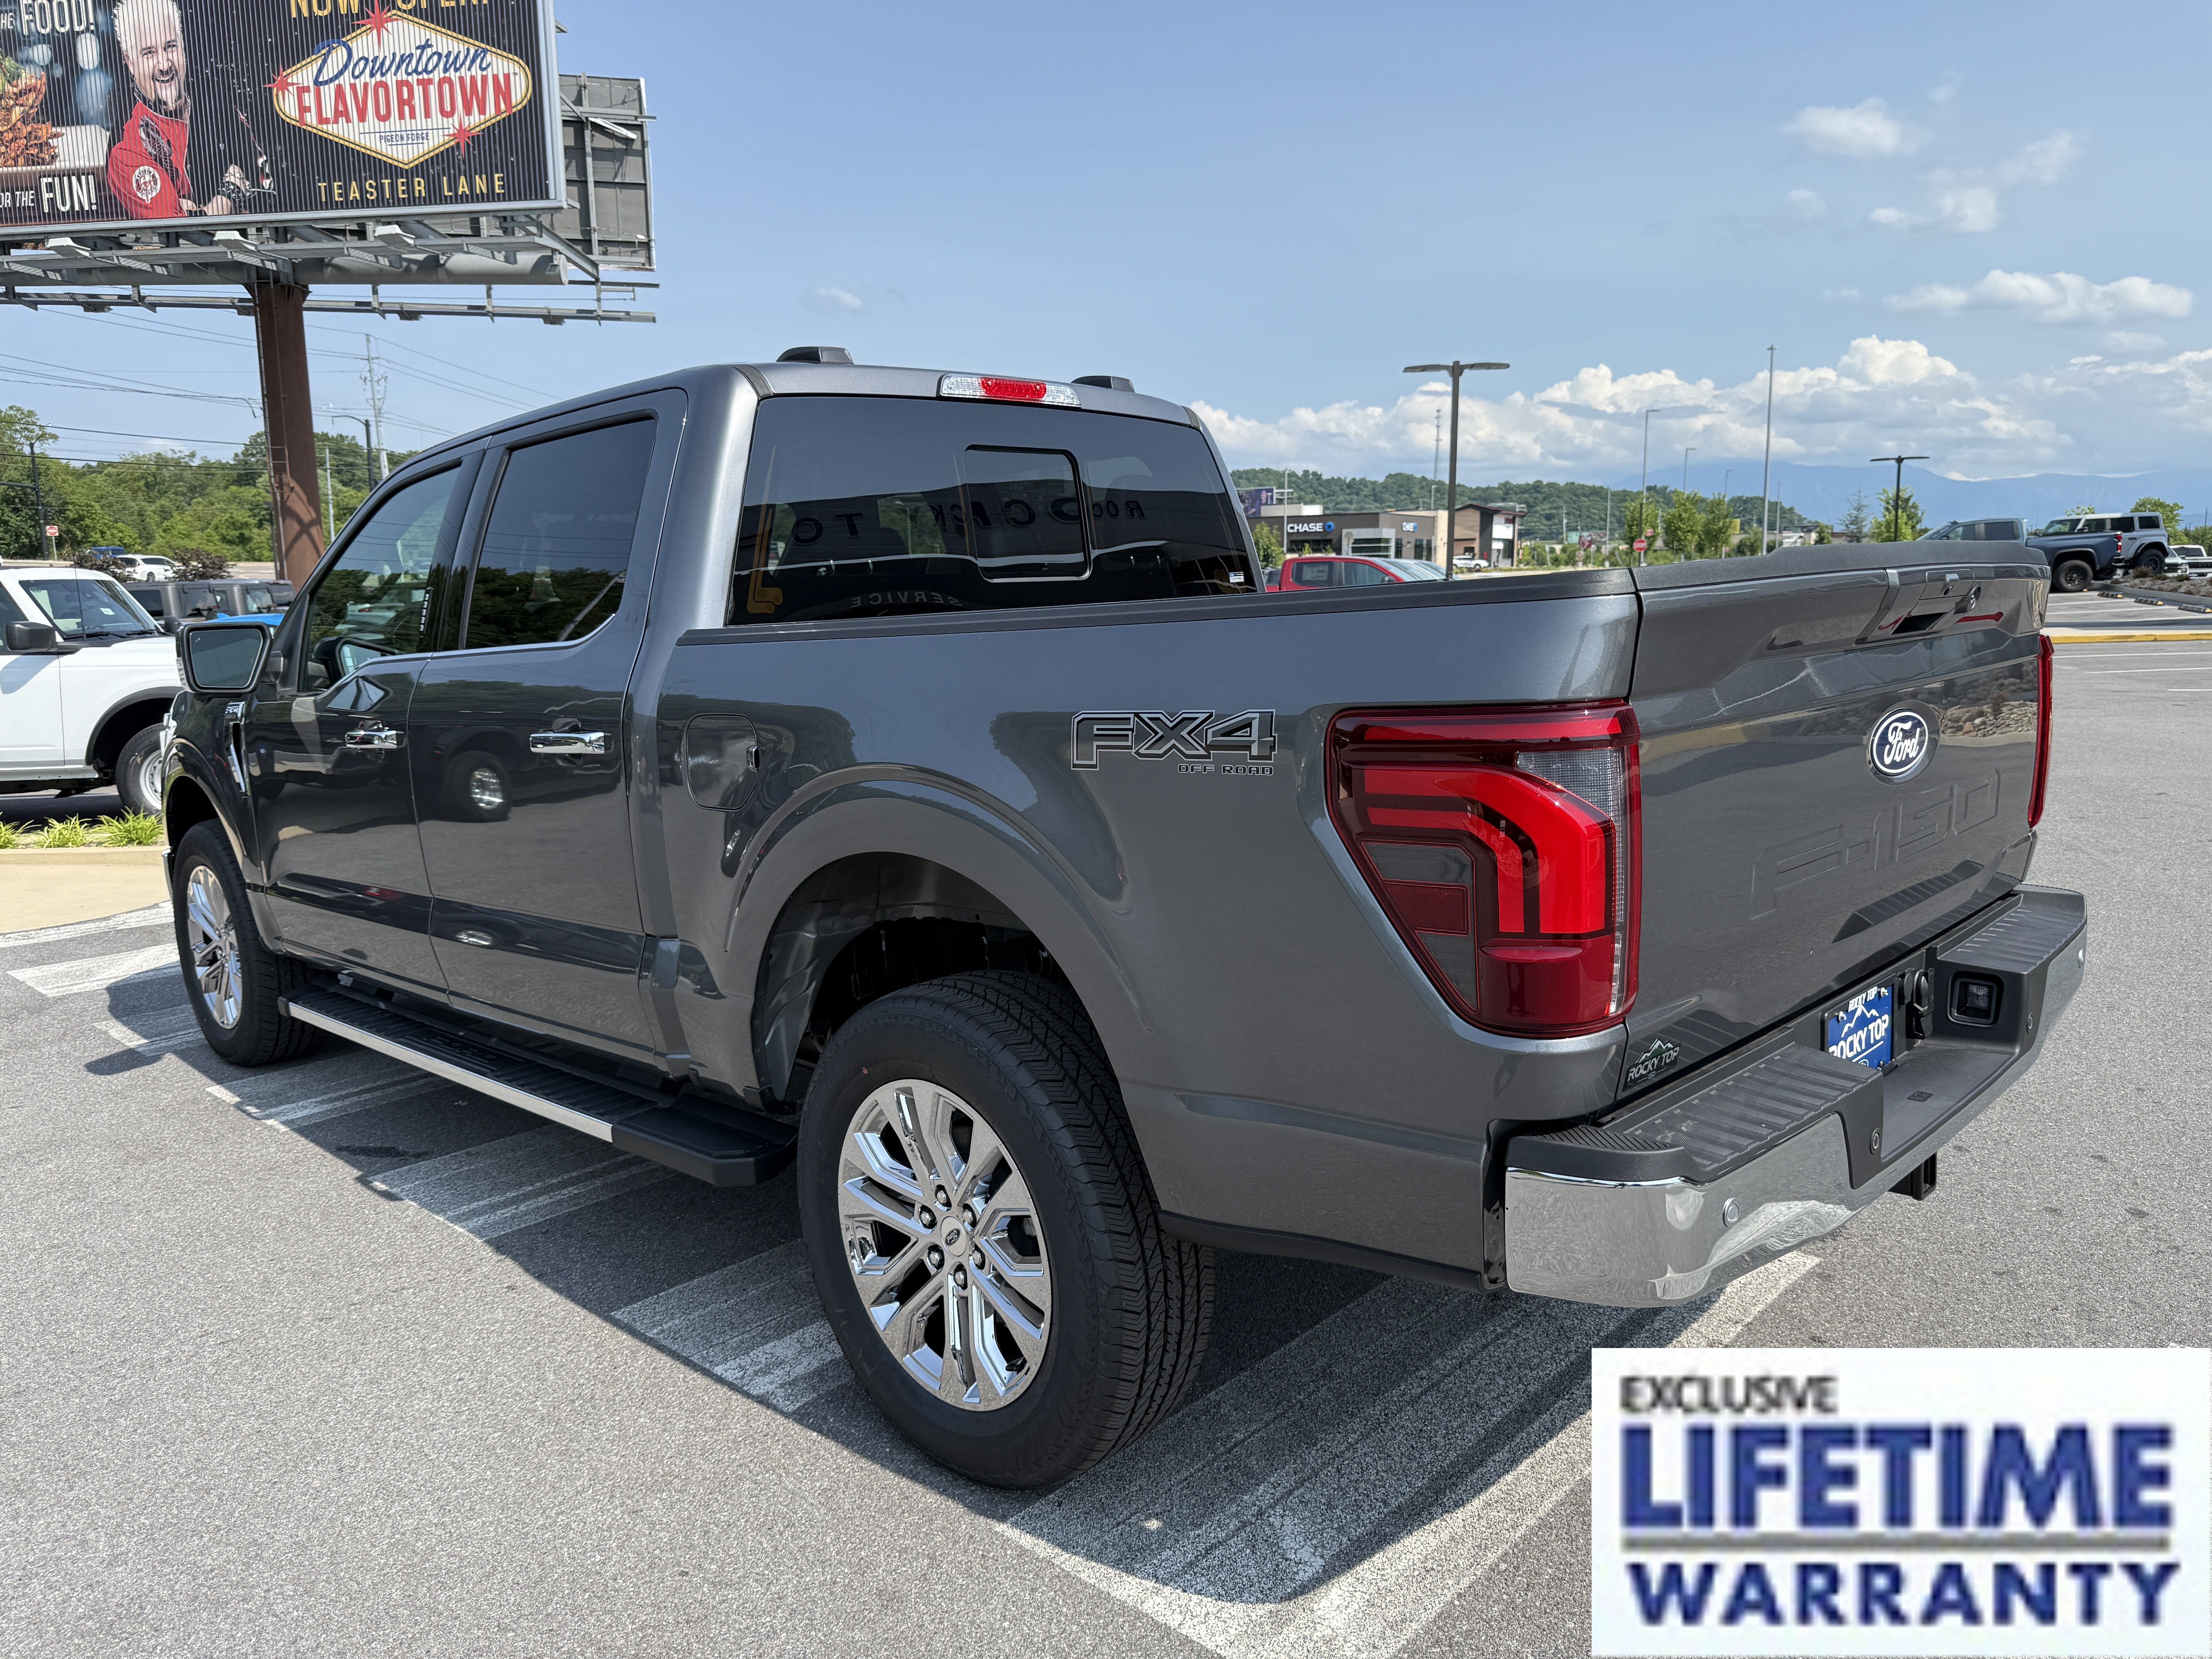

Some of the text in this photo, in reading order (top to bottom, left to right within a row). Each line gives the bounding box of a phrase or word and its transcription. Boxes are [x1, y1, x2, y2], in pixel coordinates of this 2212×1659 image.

[0, 0, 94, 35] HE FOOD!
[313, 38, 491, 86] Downtown
[296, 73, 513, 126] FLAVORTOWN
[379, 132, 429, 143] PIGEON FORGE
[0, 175, 97, 213] OR THE FUN!
[318, 173, 505, 202] TEASTER LANE
[1287, 523, 1324, 532] CHASE
[1071, 709, 1278, 771] FX4
[1884, 721, 1920, 765] Ford
[1177, 763, 1274, 776] OFF ROAD
[1868, 1014, 1889, 1044] TOP
[1627, 1046, 1680, 1082] ROCKY TOP
